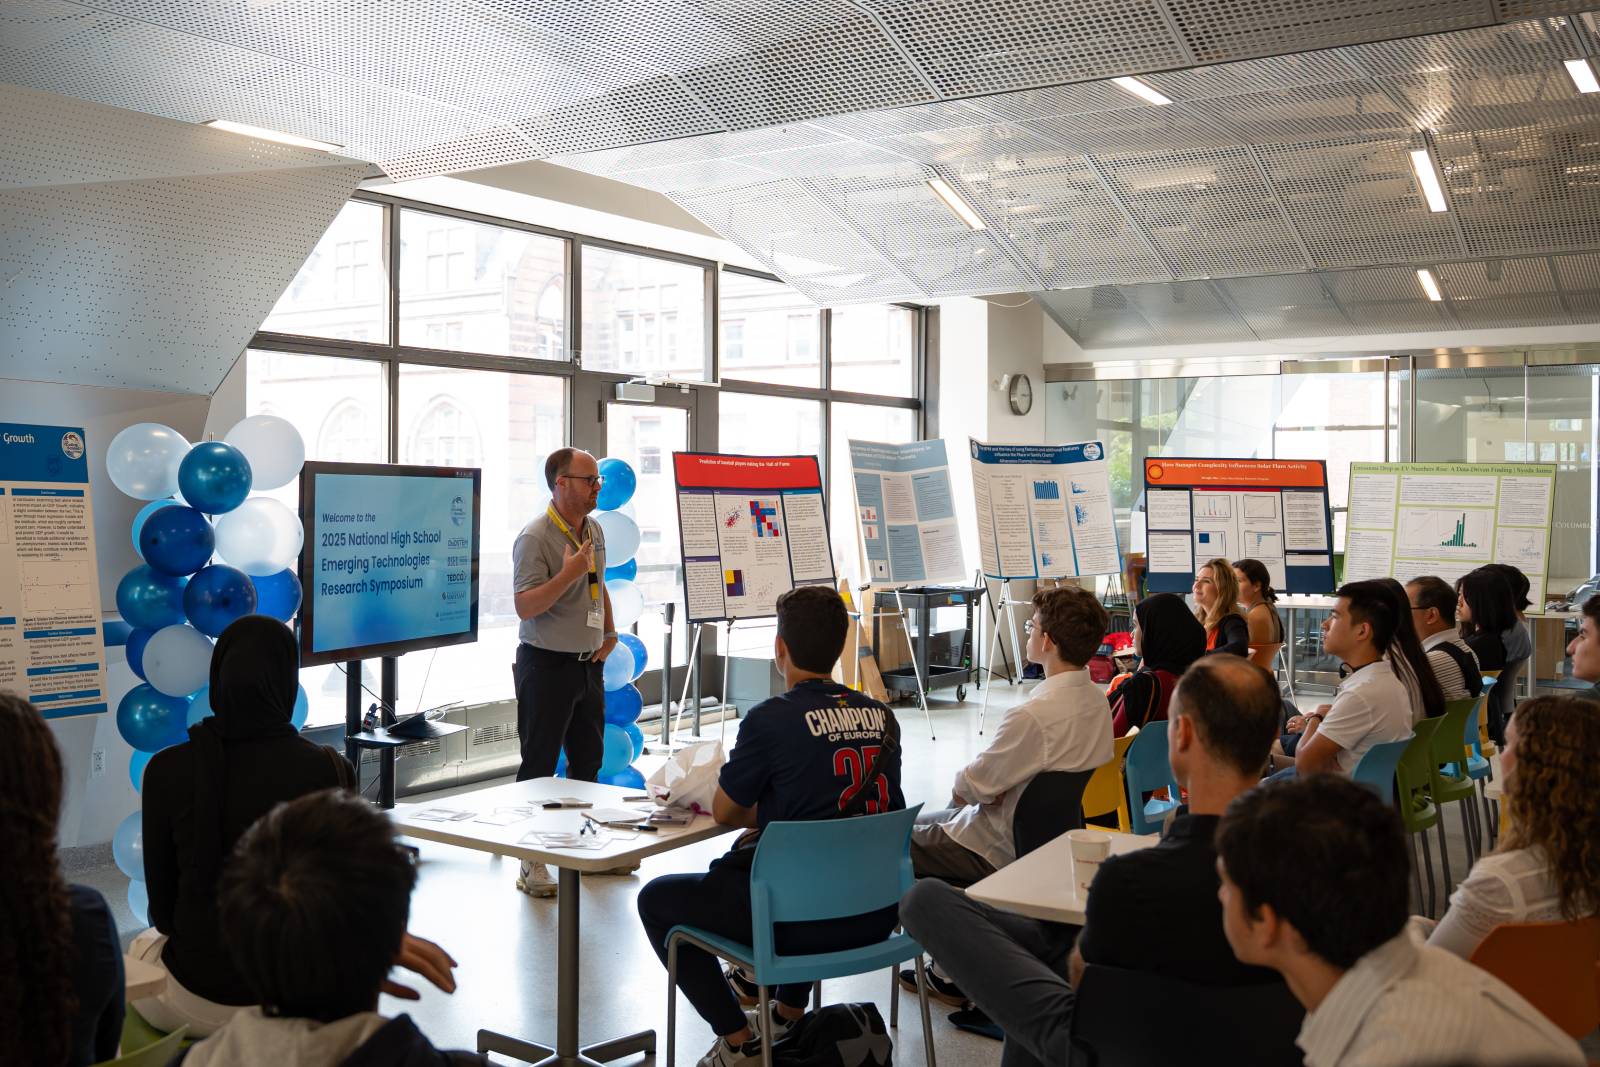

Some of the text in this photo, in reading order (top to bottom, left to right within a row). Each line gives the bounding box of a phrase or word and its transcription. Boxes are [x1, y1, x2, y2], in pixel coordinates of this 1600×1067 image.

[3, 432, 35, 444] Growth
[322, 512, 376, 523] Welcome to the
[1555, 521, 1591, 529] COLUMBI
[321, 530, 441, 548] 2025 National High School
[321, 555, 369, 574] Emerging
[371, 552, 430, 571] Technologies
[321, 575, 423, 596] Research Symposium
[804, 707, 886, 737] CHAMPION
[829, 731, 882, 742] OF EUROPE
